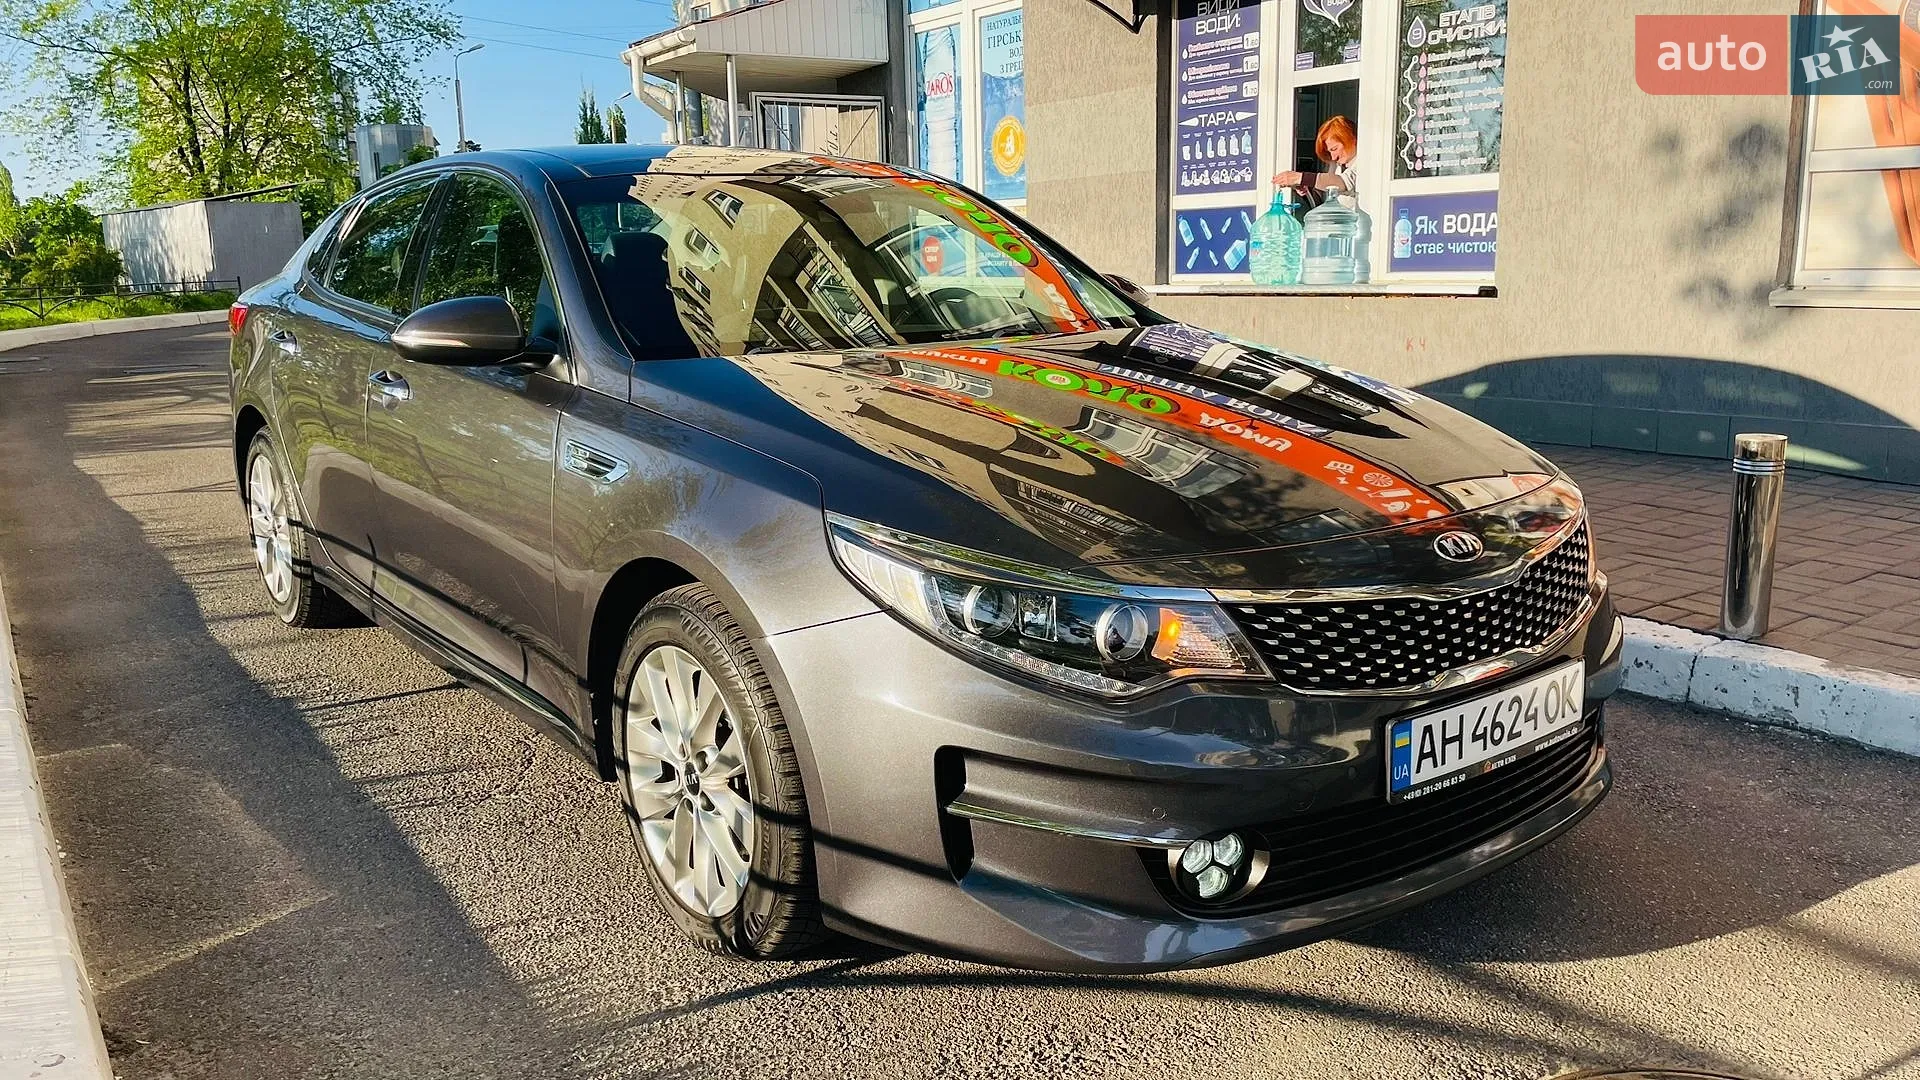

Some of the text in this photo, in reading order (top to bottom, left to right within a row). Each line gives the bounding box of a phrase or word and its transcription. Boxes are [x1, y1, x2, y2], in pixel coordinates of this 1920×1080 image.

[1439, 4, 1496, 27] ЕТАПІВ
[1412, 28, 1422, 40] 9
[1198, 111, 1236, 127] ТАРА
[1415, 212, 1498, 237] Як ВОДА
[1414, 243, 1444, 254] стає
[1440, 534, 1479, 557] KIA
[1415, 668, 1579, 774] AH 4624 OK
[1394, 764, 1409, 781] UA
